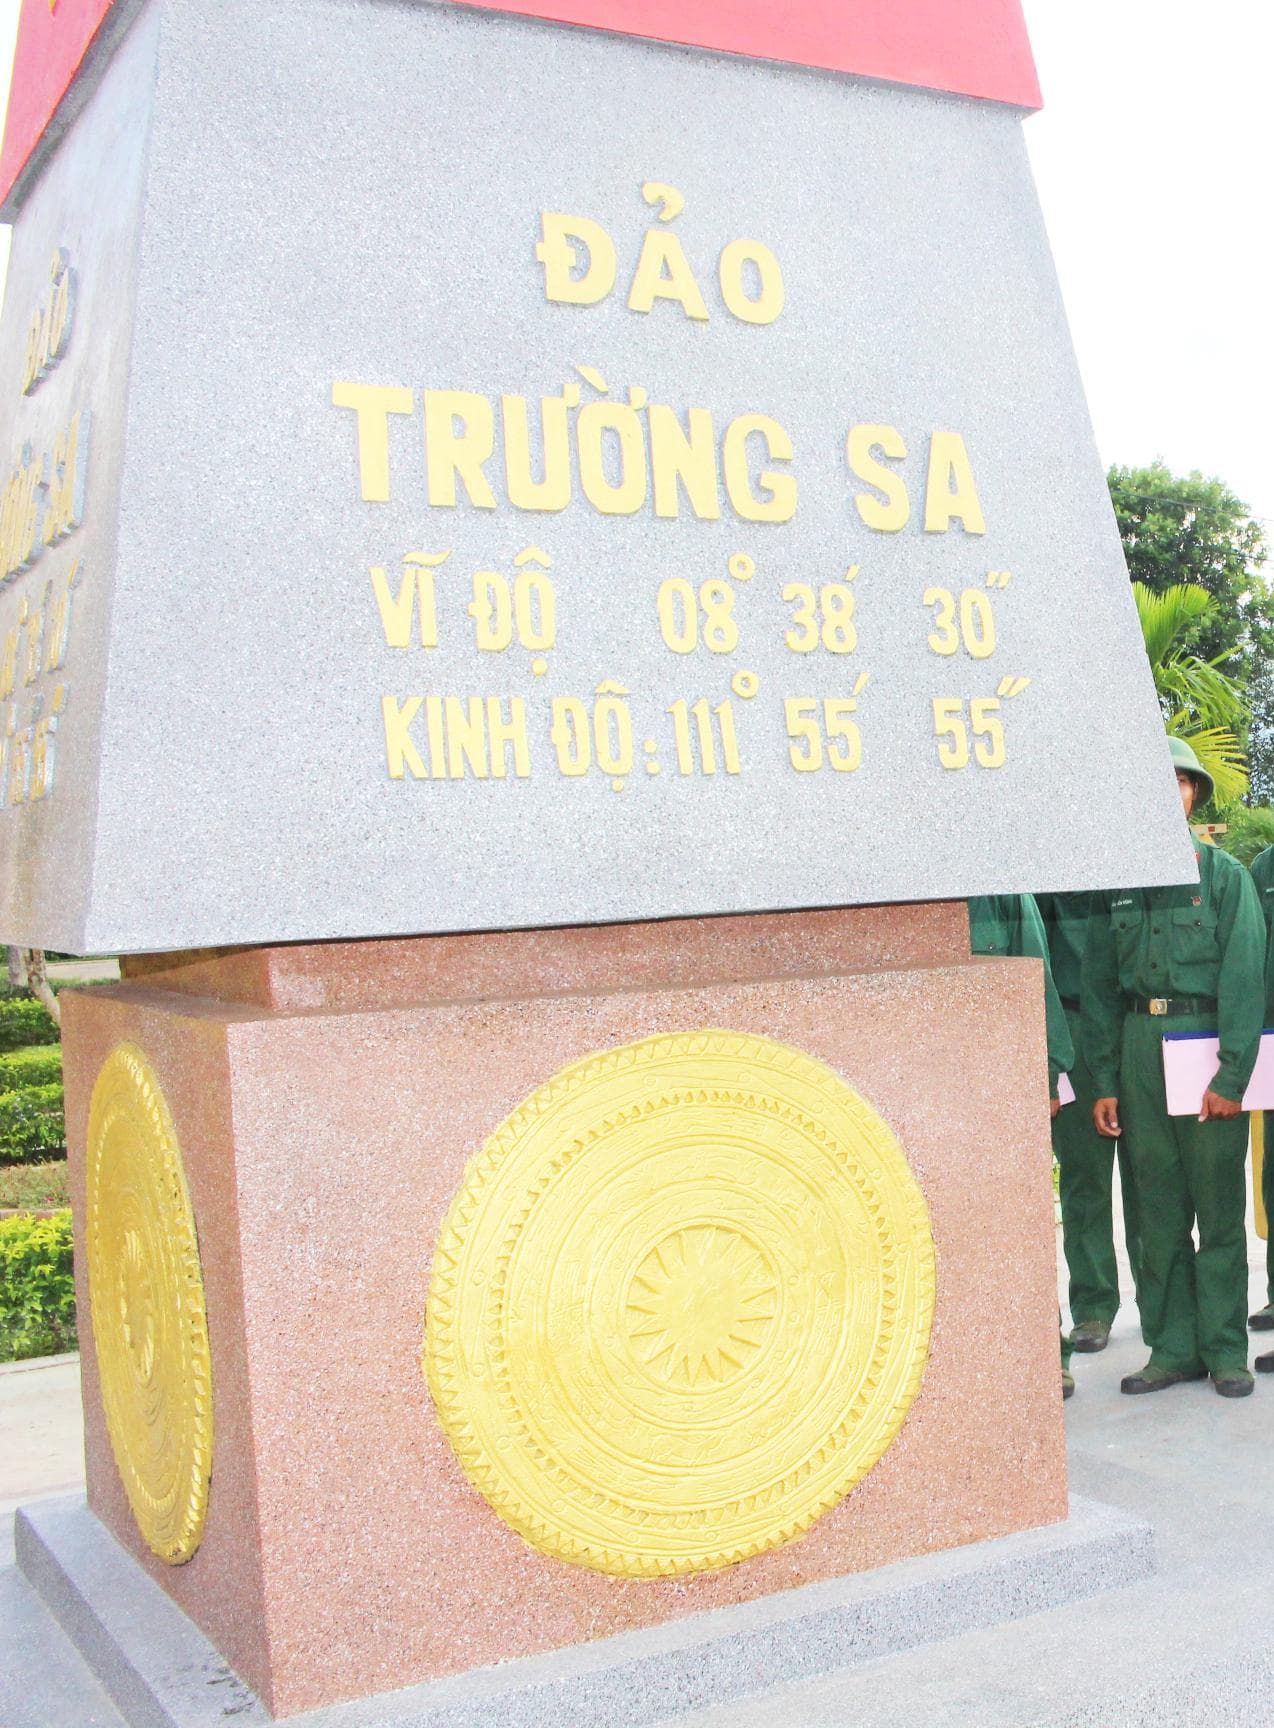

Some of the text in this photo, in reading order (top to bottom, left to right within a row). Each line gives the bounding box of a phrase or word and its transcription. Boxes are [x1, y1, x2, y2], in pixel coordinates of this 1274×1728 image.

[537, 183, 783, 324] ĐẢO
[333, 367, 985, 533] TRƯỜNG SA
[369, 551, 448, 649] VĨ
[468, 547, 554, 677] ĐỘ
[383, 696, 528, 779] KINH
